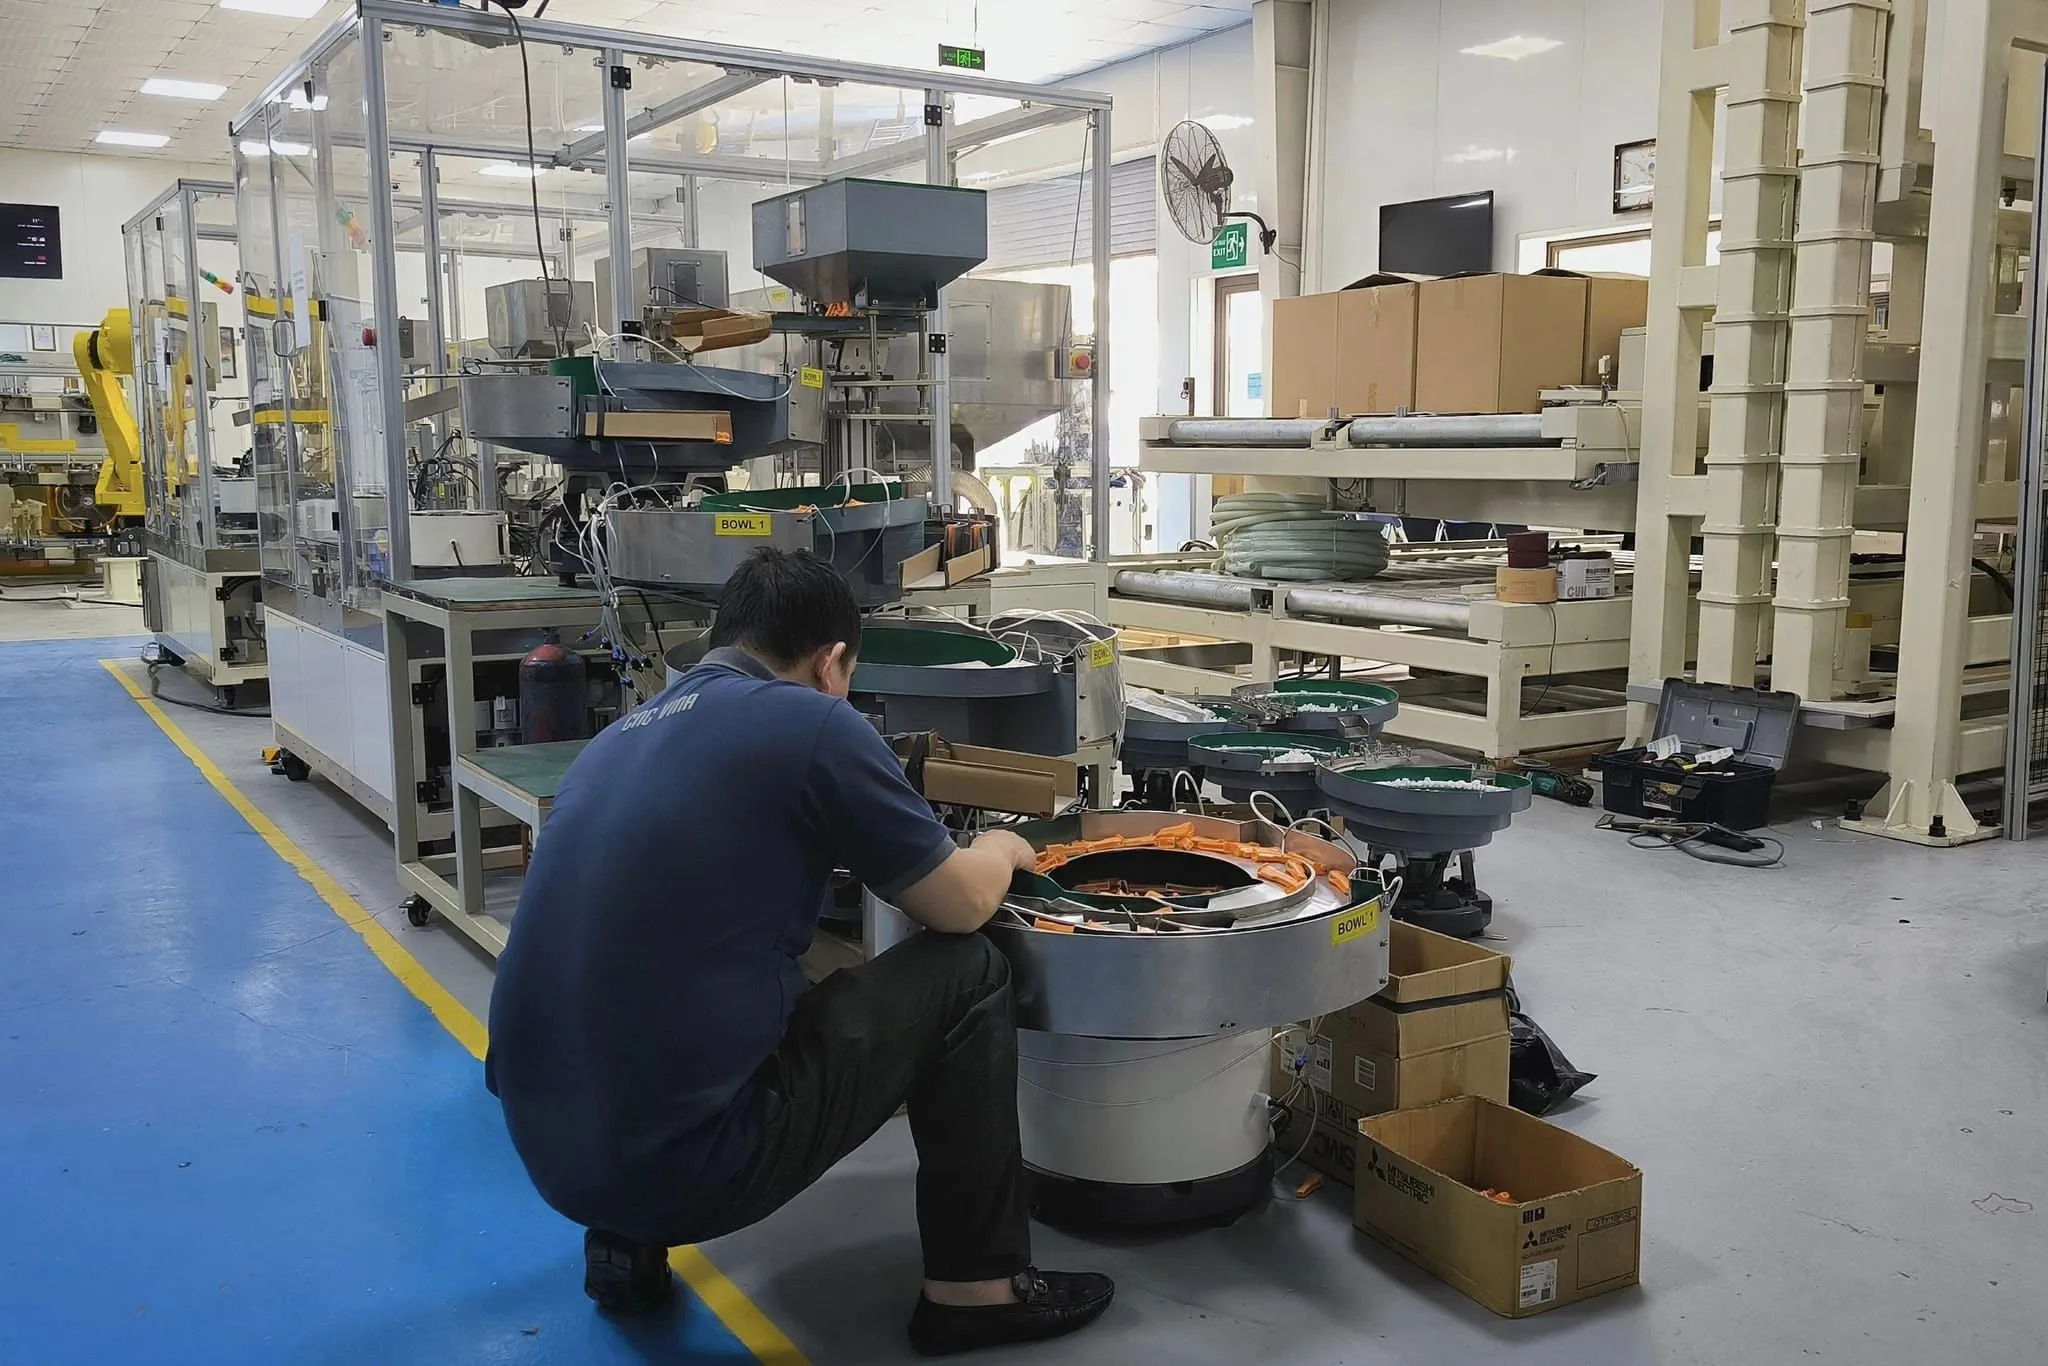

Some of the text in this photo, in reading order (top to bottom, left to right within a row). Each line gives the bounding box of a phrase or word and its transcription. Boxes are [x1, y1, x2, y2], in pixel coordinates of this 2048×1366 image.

[1213, 247, 1226, 257] EXIT
[721, 519, 764, 530] BOWL 1
[621, 693, 700, 732] CNC VINA
[1338, 910, 1373, 936] BOWL 1
[1387, 1163, 1435, 1197] MITSUBISHI
[1387, 1174, 1429, 1205] ELECTRIC
